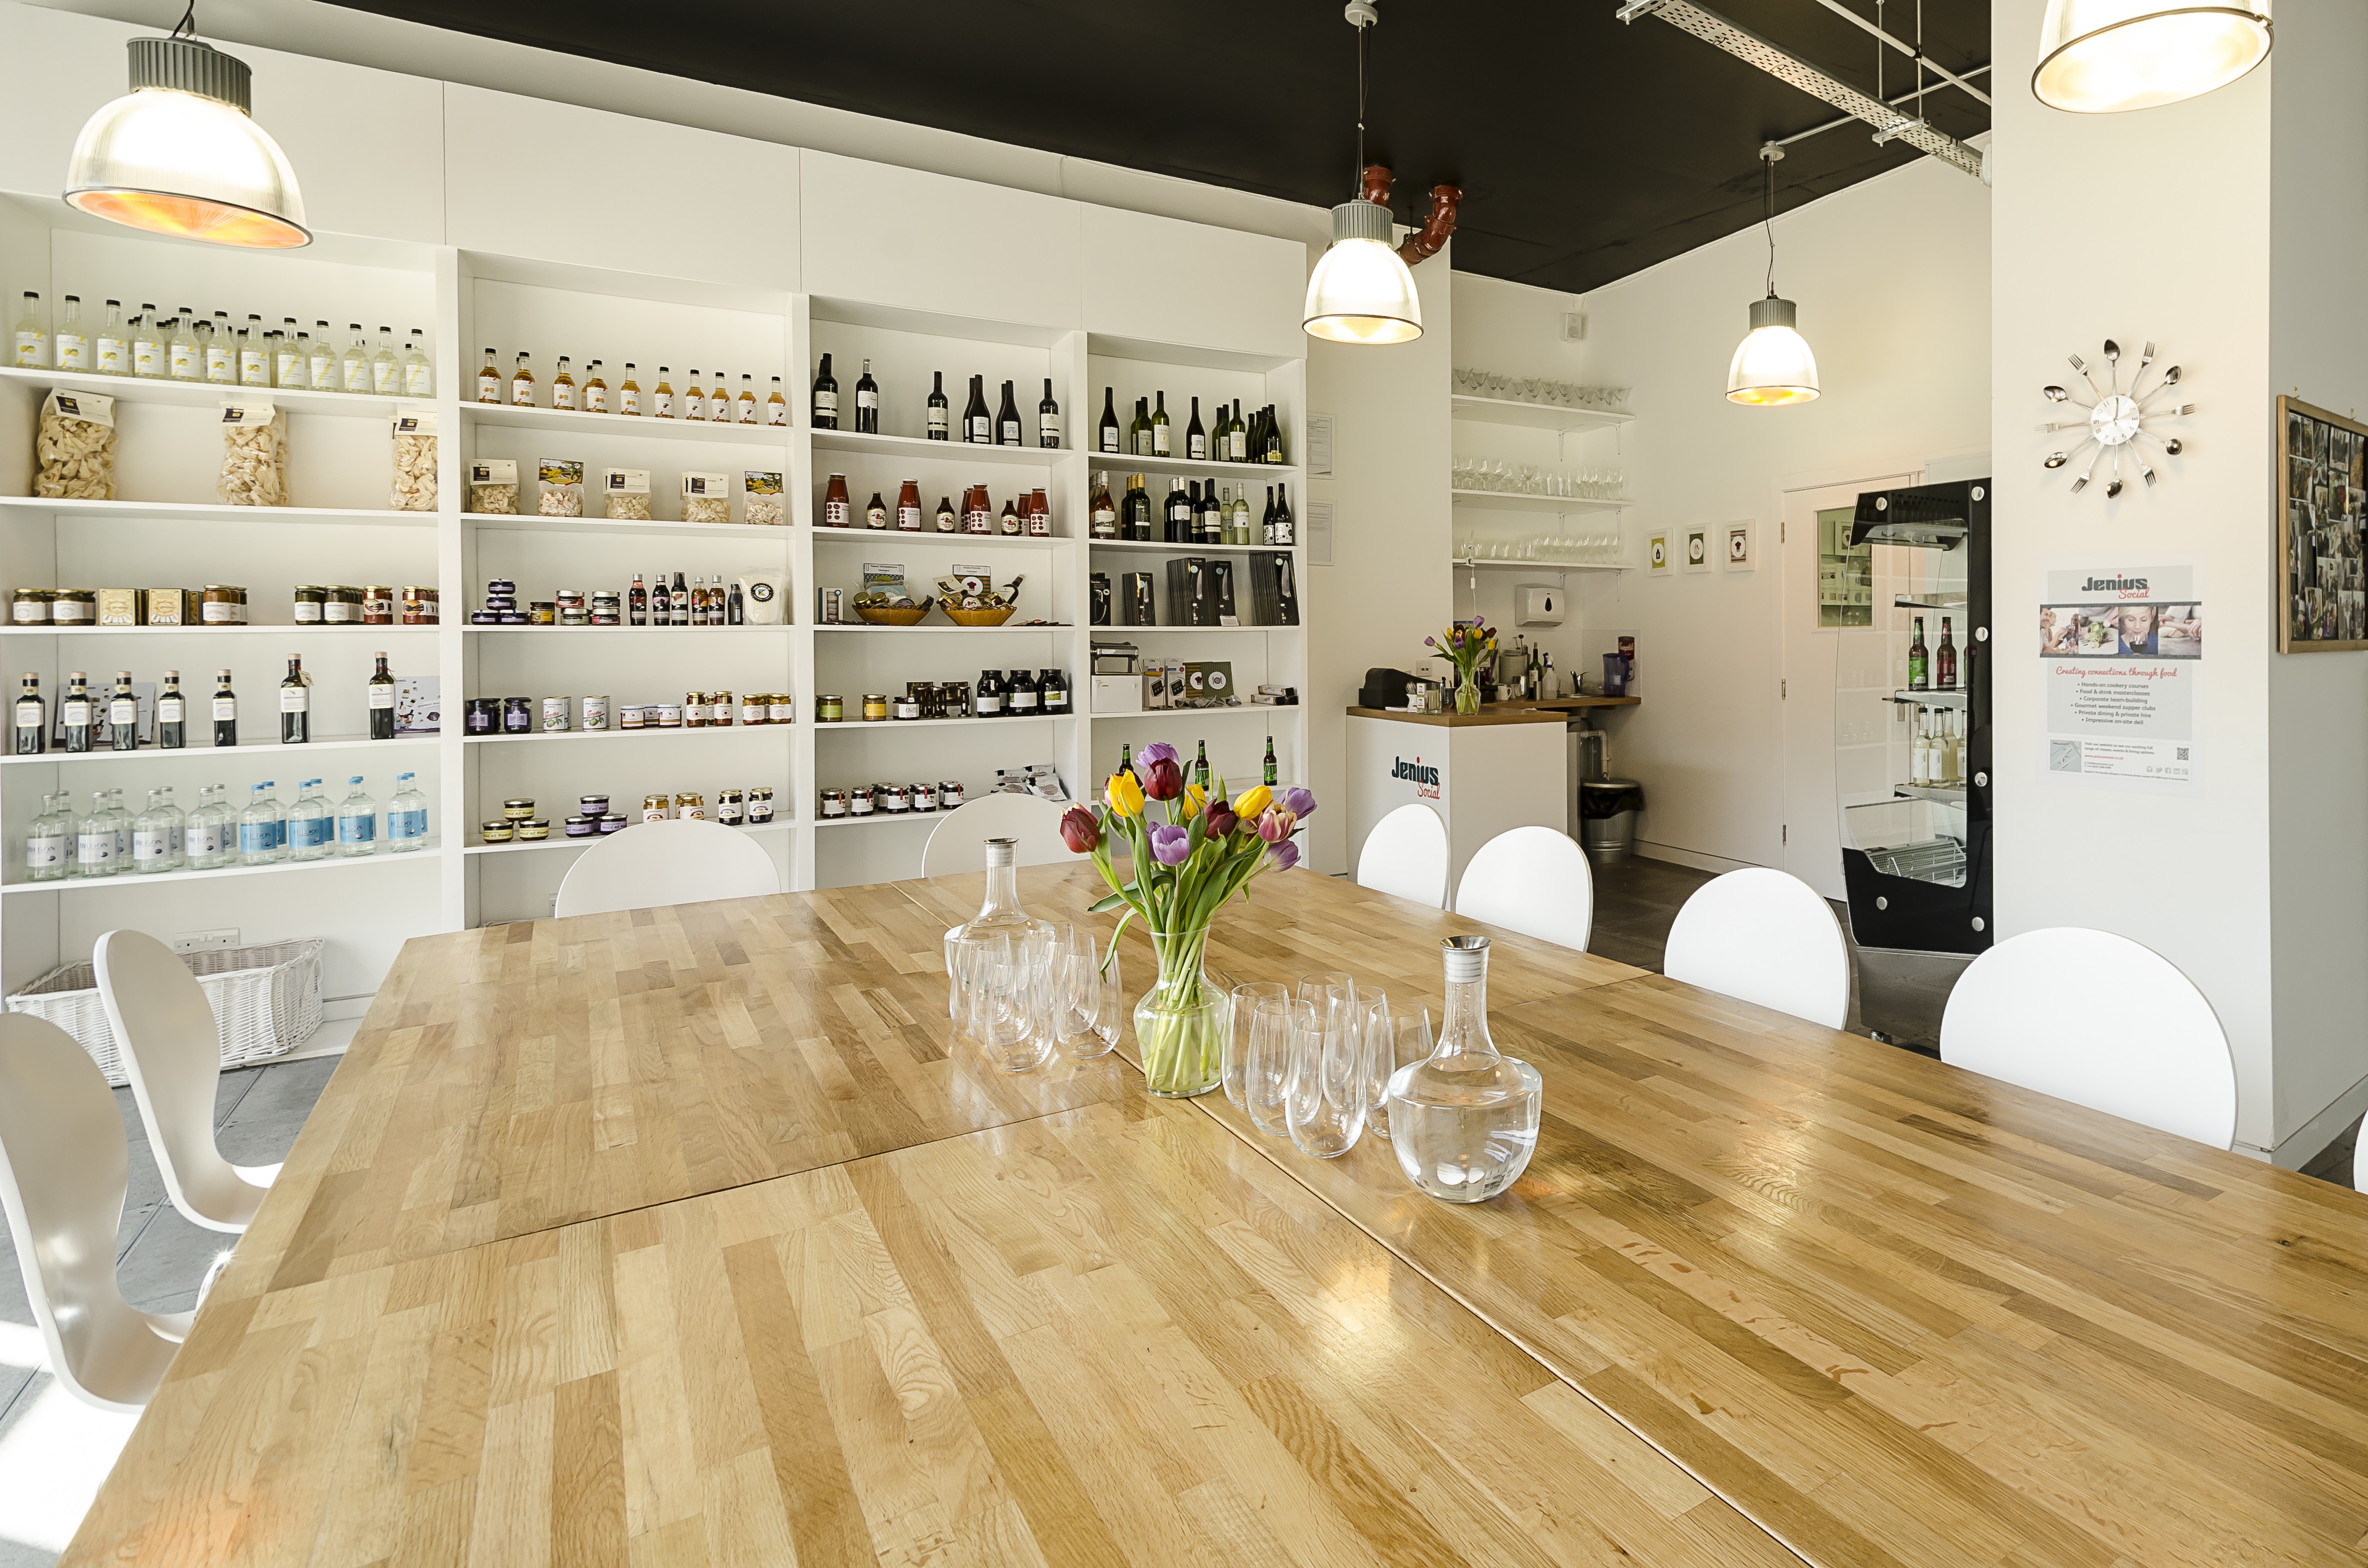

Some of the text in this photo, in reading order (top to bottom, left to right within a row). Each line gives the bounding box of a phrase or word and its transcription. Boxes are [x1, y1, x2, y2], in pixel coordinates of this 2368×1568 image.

[2081, 574, 2148, 591] Jenius
[2118, 587, 2150, 599] Social
[2056, 666, 2177, 680] Creating connections through food
[1391, 756, 1438, 786] Jenius
[1418, 780, 1440, 800] Social
